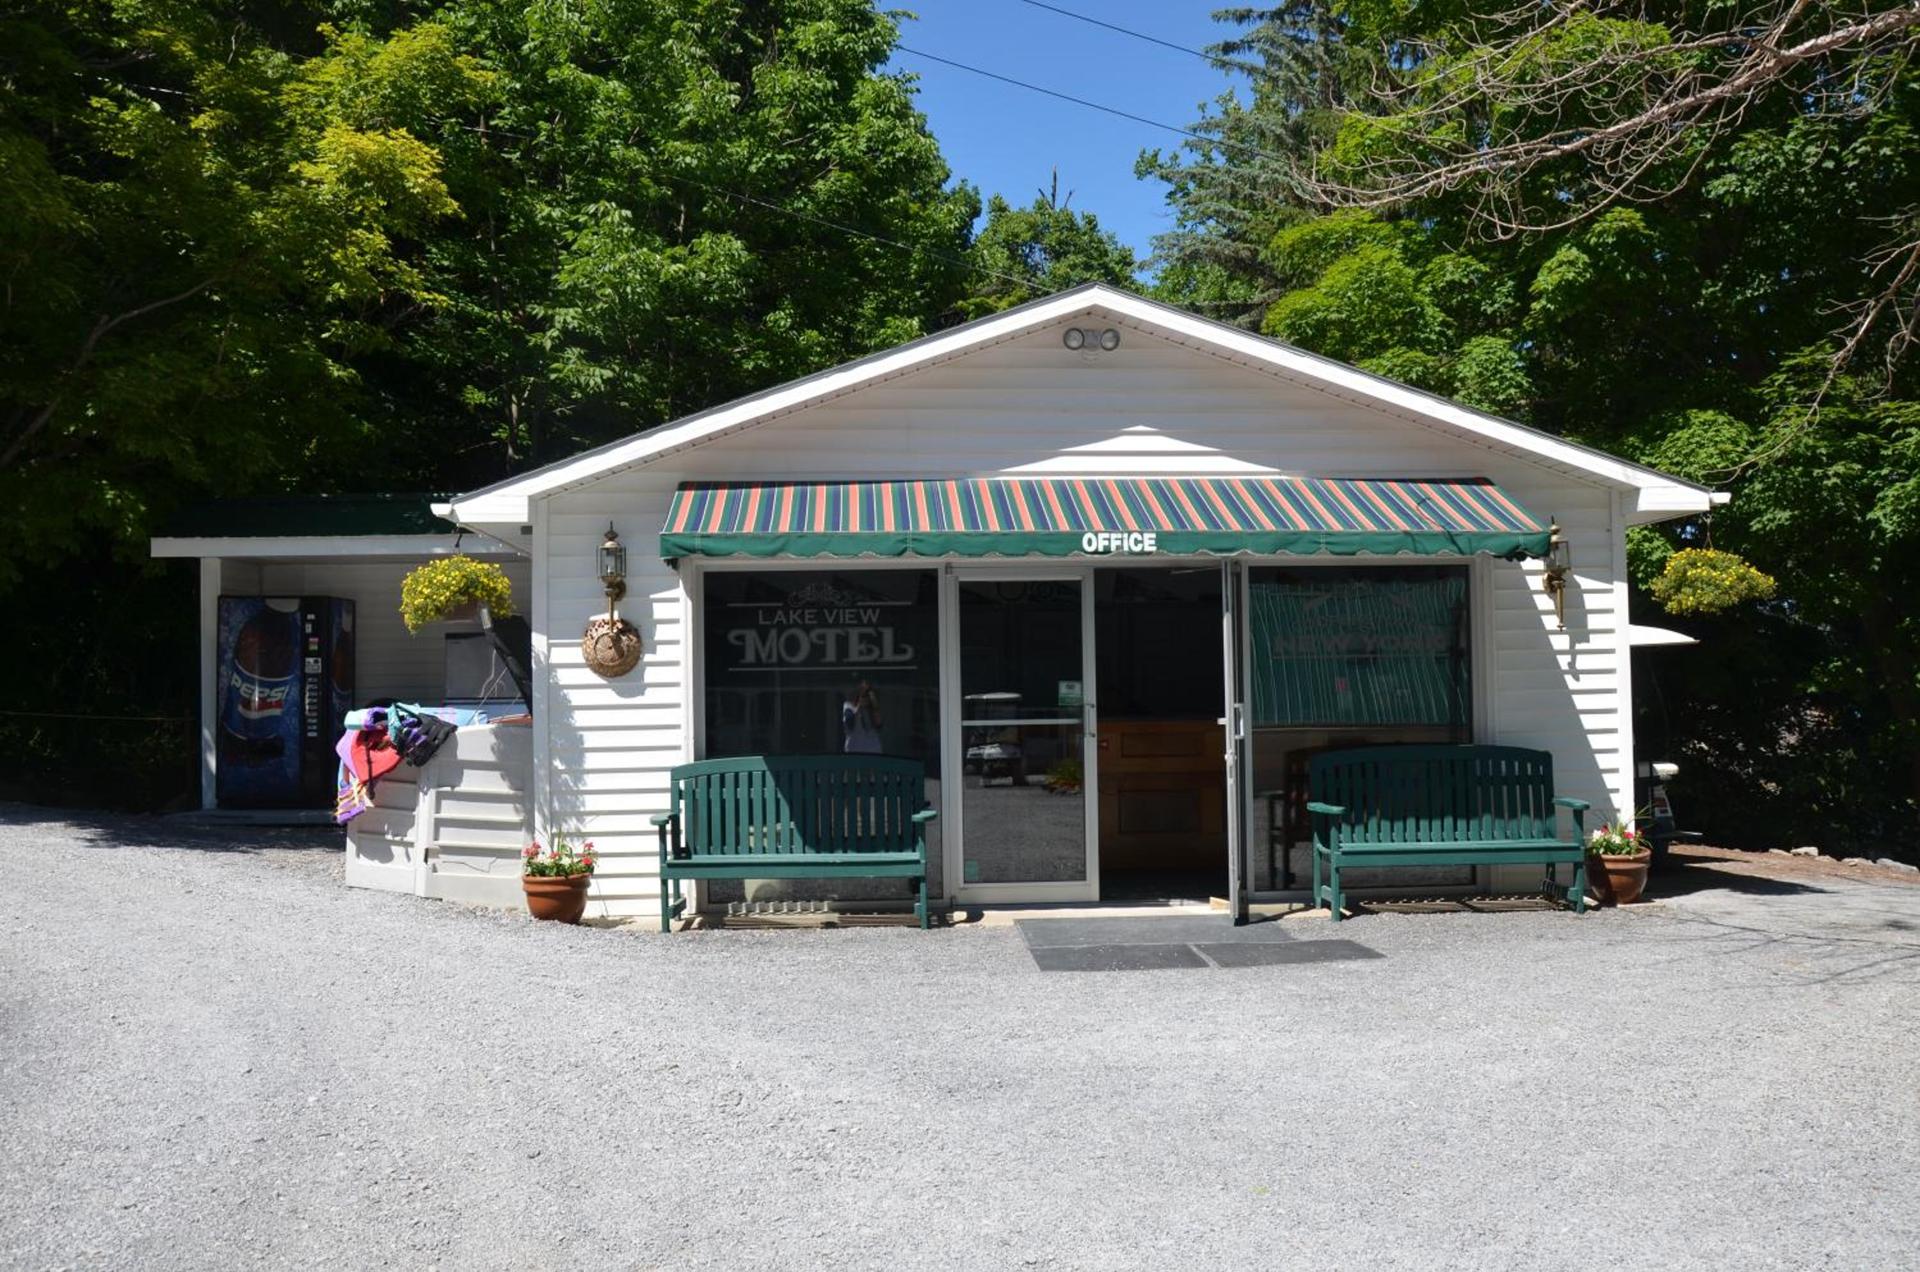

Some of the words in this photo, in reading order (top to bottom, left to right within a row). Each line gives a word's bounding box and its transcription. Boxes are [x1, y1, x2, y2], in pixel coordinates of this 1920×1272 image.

[1082, 532, 1157, 552] OFFICE
[758, 609, 818, 625] LAKE
[823, 608, 881, 624] VIEW
[727, 626, 915, 664] MOTEL
[231, 671, 290, 703] PEPSI
